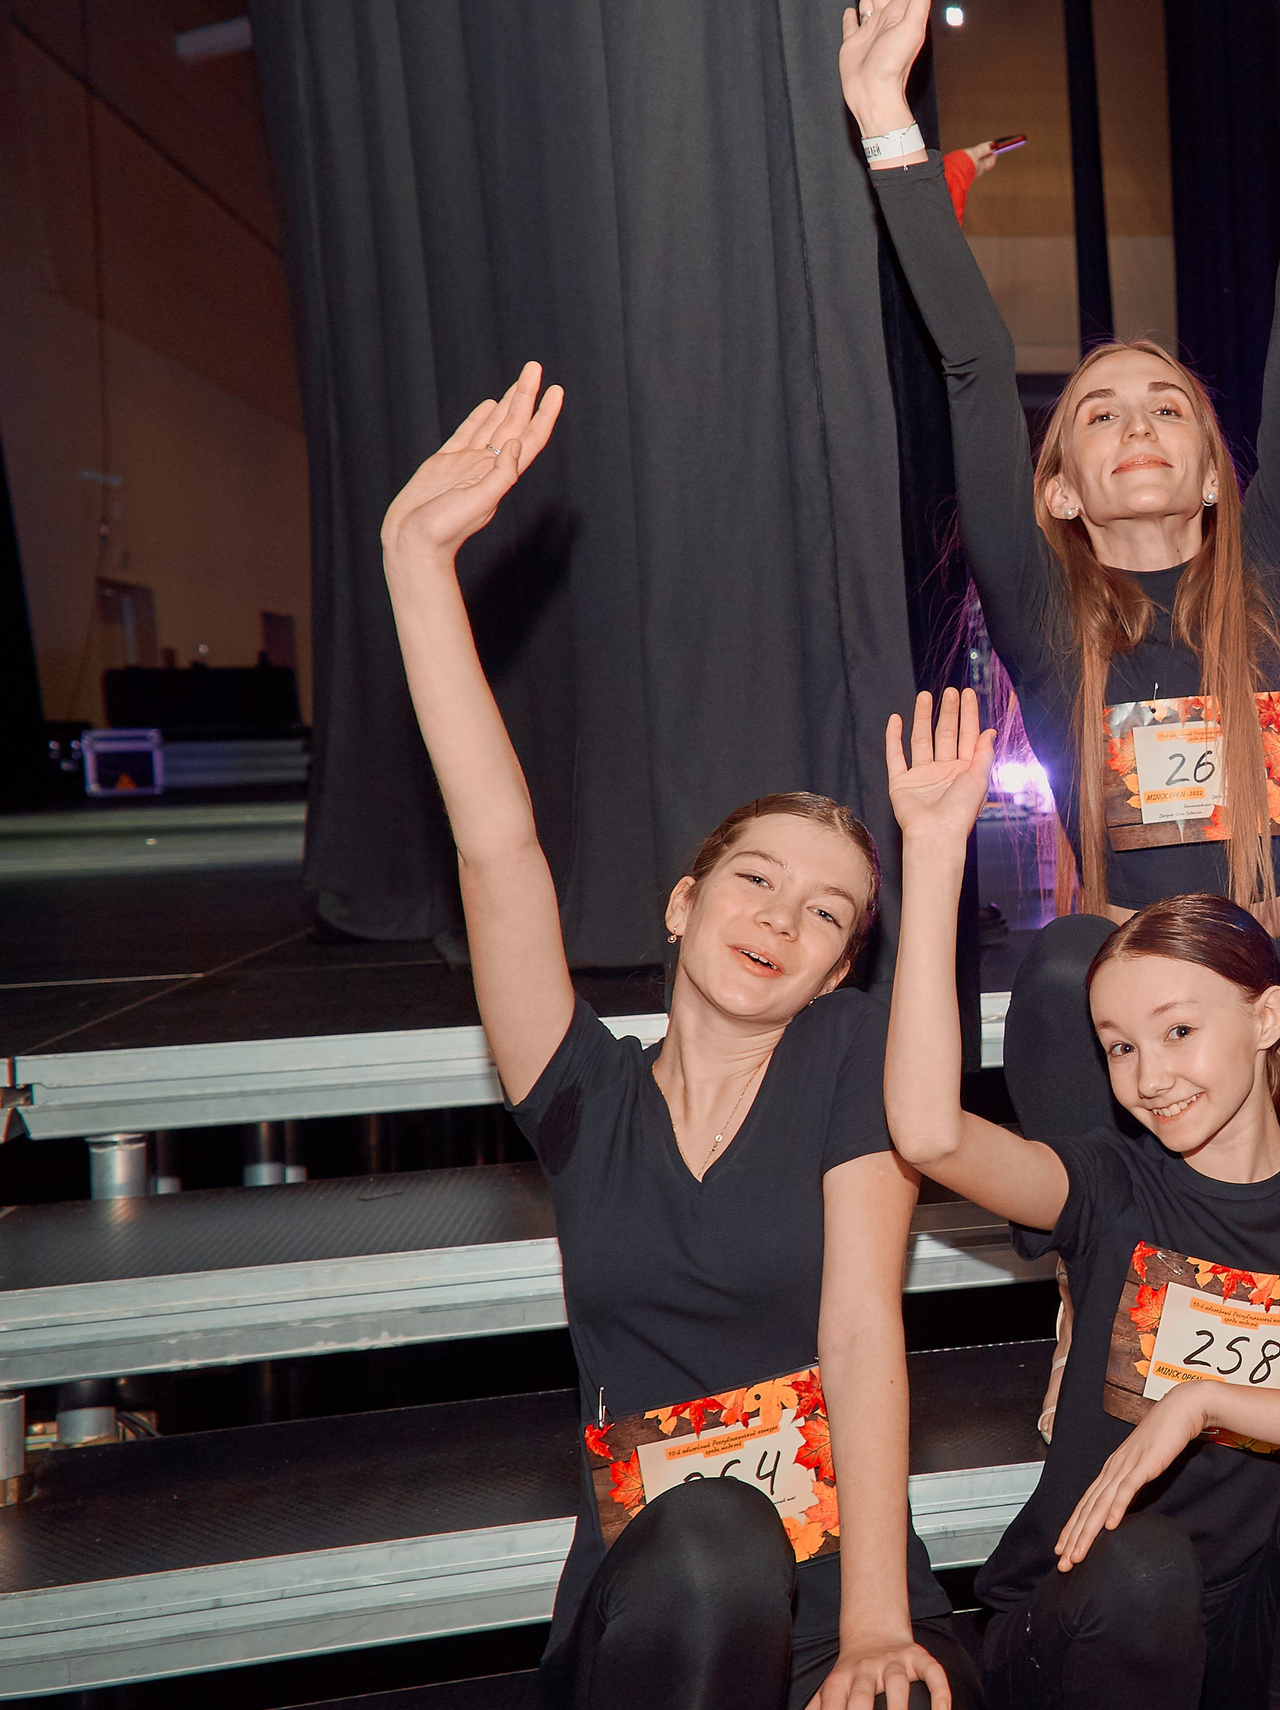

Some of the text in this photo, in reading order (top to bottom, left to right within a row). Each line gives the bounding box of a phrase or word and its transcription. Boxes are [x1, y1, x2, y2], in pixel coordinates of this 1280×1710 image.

[1166, 750, 1215, 786] 26
[1146, 792, 1168, 801] MINSK
[1156, 1366, 1183, 1381] MINSK
